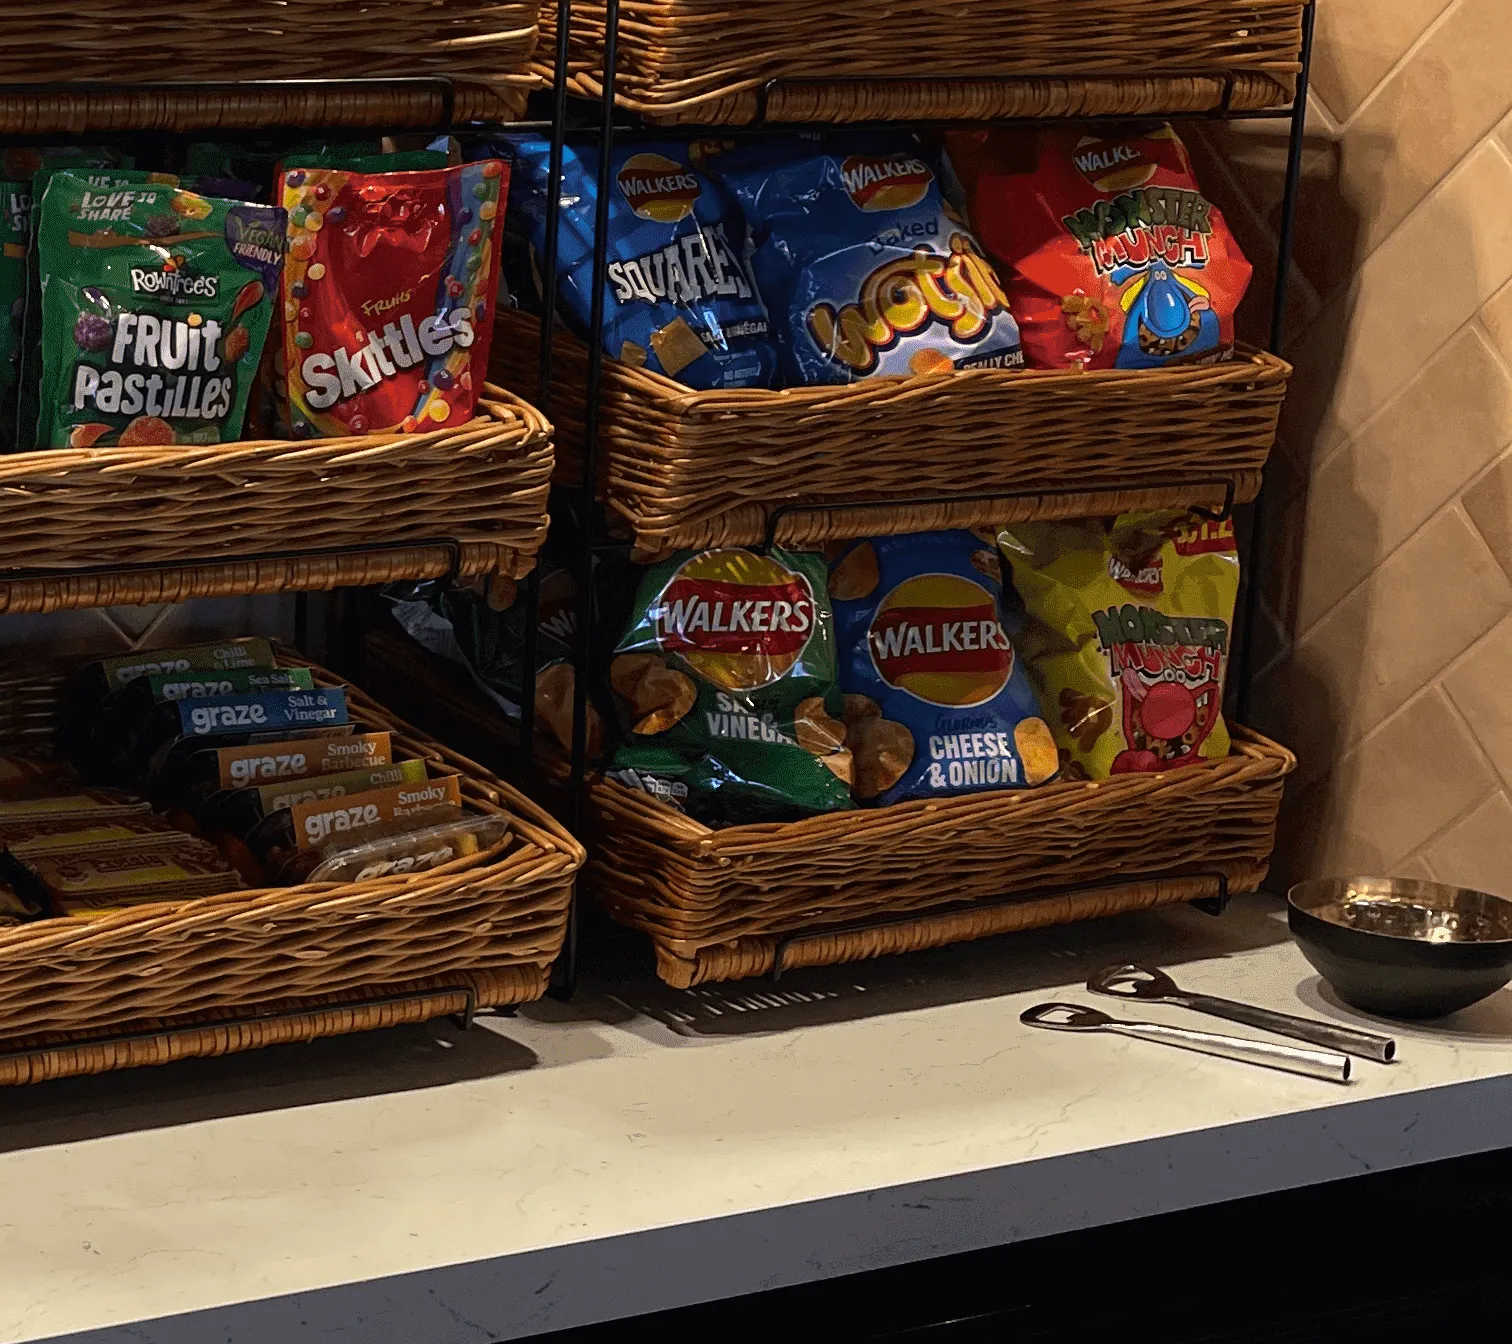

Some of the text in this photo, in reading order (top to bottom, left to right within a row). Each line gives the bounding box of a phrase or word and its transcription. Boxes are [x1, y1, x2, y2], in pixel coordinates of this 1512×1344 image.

[618, 172, 698, 198] WALKERS
[842, 158, 926, 193] WALKERS
[76, 205, 132, 222] SHARE
[81, 191, 136, 209] LOVE
[235, 218, 286, 248] VEGAN
[1062, 187, 1213, 249] MONSTER
[869, 218, 939, 256] Baked
[1091, 226, 1210, 276] MUNCH
[234, 243, 283, 266] FRIENDLY
[130, 268, 219, 298] Rowntree's
[301, 307, 475, 409] Skittles
[661, 598, 811, 634] WALKERS
[872, 619, 1011, 661] WALKERS
[1111, 641, 1221, 678] MUNCH
[287, 695, 328, 708] Salt &
[191, 704, 337, 735] graze Vinegar
[327, 741, 377, 757] Smoky
[929, 732, 1012, 761] CHEESE
[230, 752, 386, 788] graze Barbecue
[929, 758, 1018, 788] & ONION
[398, 786, 447, 806] Smoky
[304, 803, 381, 844] graze
